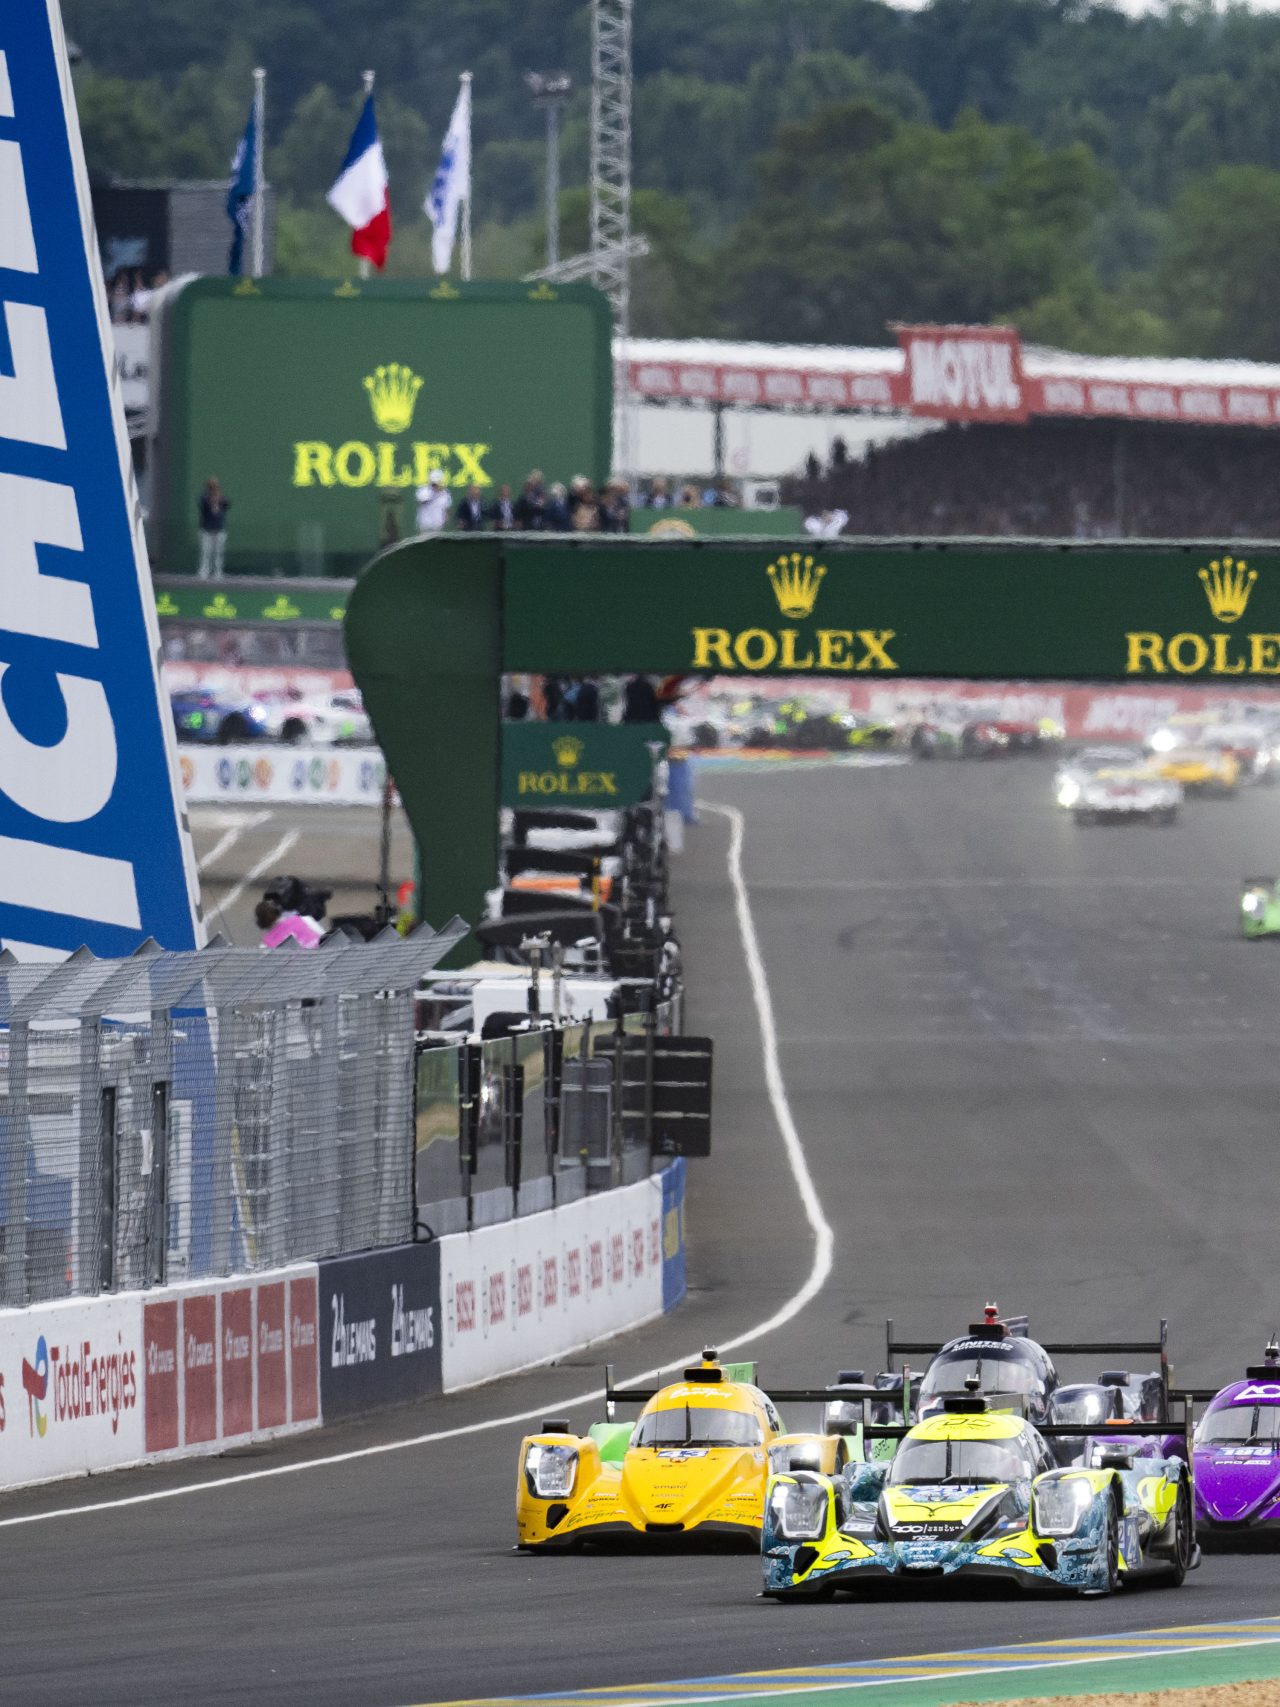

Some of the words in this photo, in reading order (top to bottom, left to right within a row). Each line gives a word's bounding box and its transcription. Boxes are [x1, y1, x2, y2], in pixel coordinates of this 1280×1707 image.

[910, 339, 1022, 408] MOTUL
[293, 441, 491, 488] ROLEX
[692, 627, 897, 670] ROLEX
[517, 771, 617, 795] ROLEX
[50, 1331, 136, 1435] TotalEnergies
